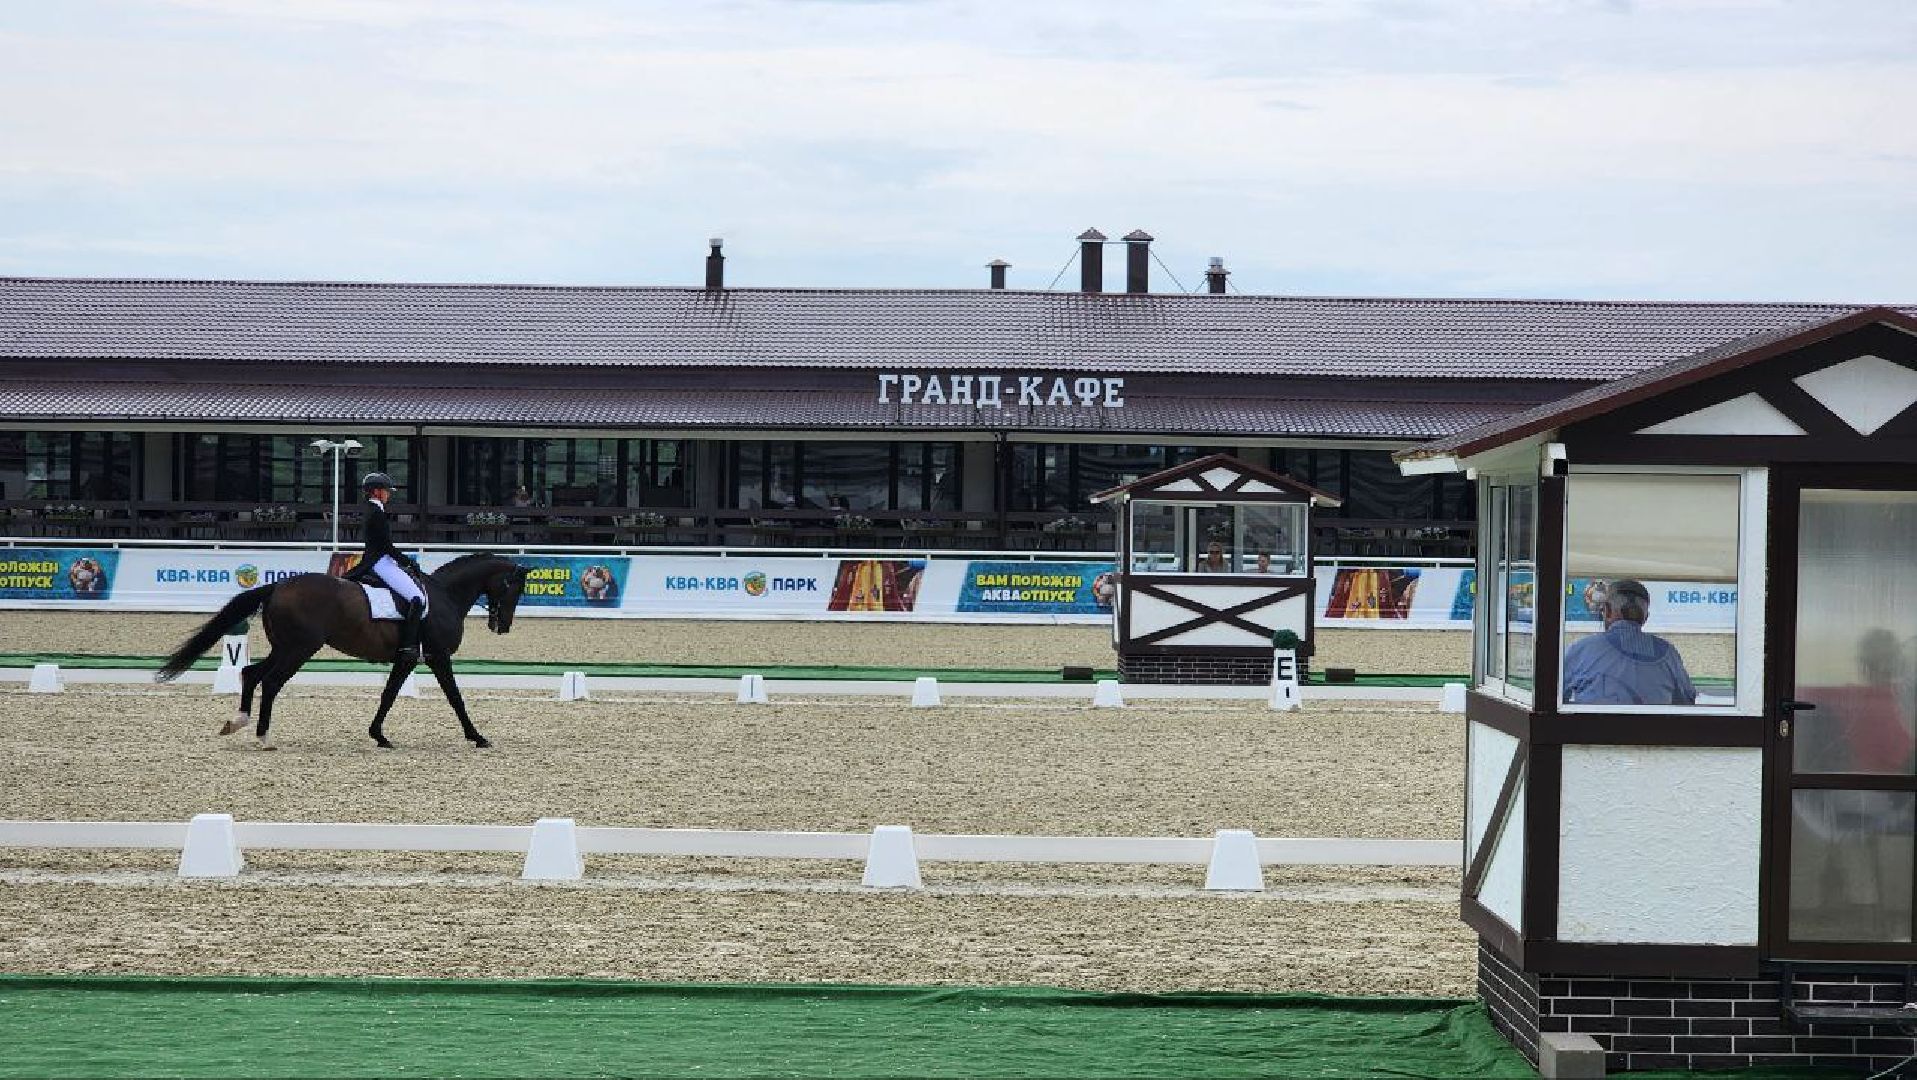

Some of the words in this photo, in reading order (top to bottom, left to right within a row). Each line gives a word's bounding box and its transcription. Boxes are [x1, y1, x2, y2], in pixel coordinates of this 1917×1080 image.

[878, 374, 1125, 409] ГРАНД-КАФЕ
[156, 569, 230, 583] КВА-КВА
[665, 576, 739, 590] КВА-КВА
[772, 577, 817, 591] ПАРК
[976, 574, 1008, 586] ВАМ
[1011, 574, 1082, 588] ПОЛОЖЕН
[982, 589, 1076, 602] АКВАОТПУСК
[226, 643, 242, 666] V
[1277, 656, 1294, 680] E
